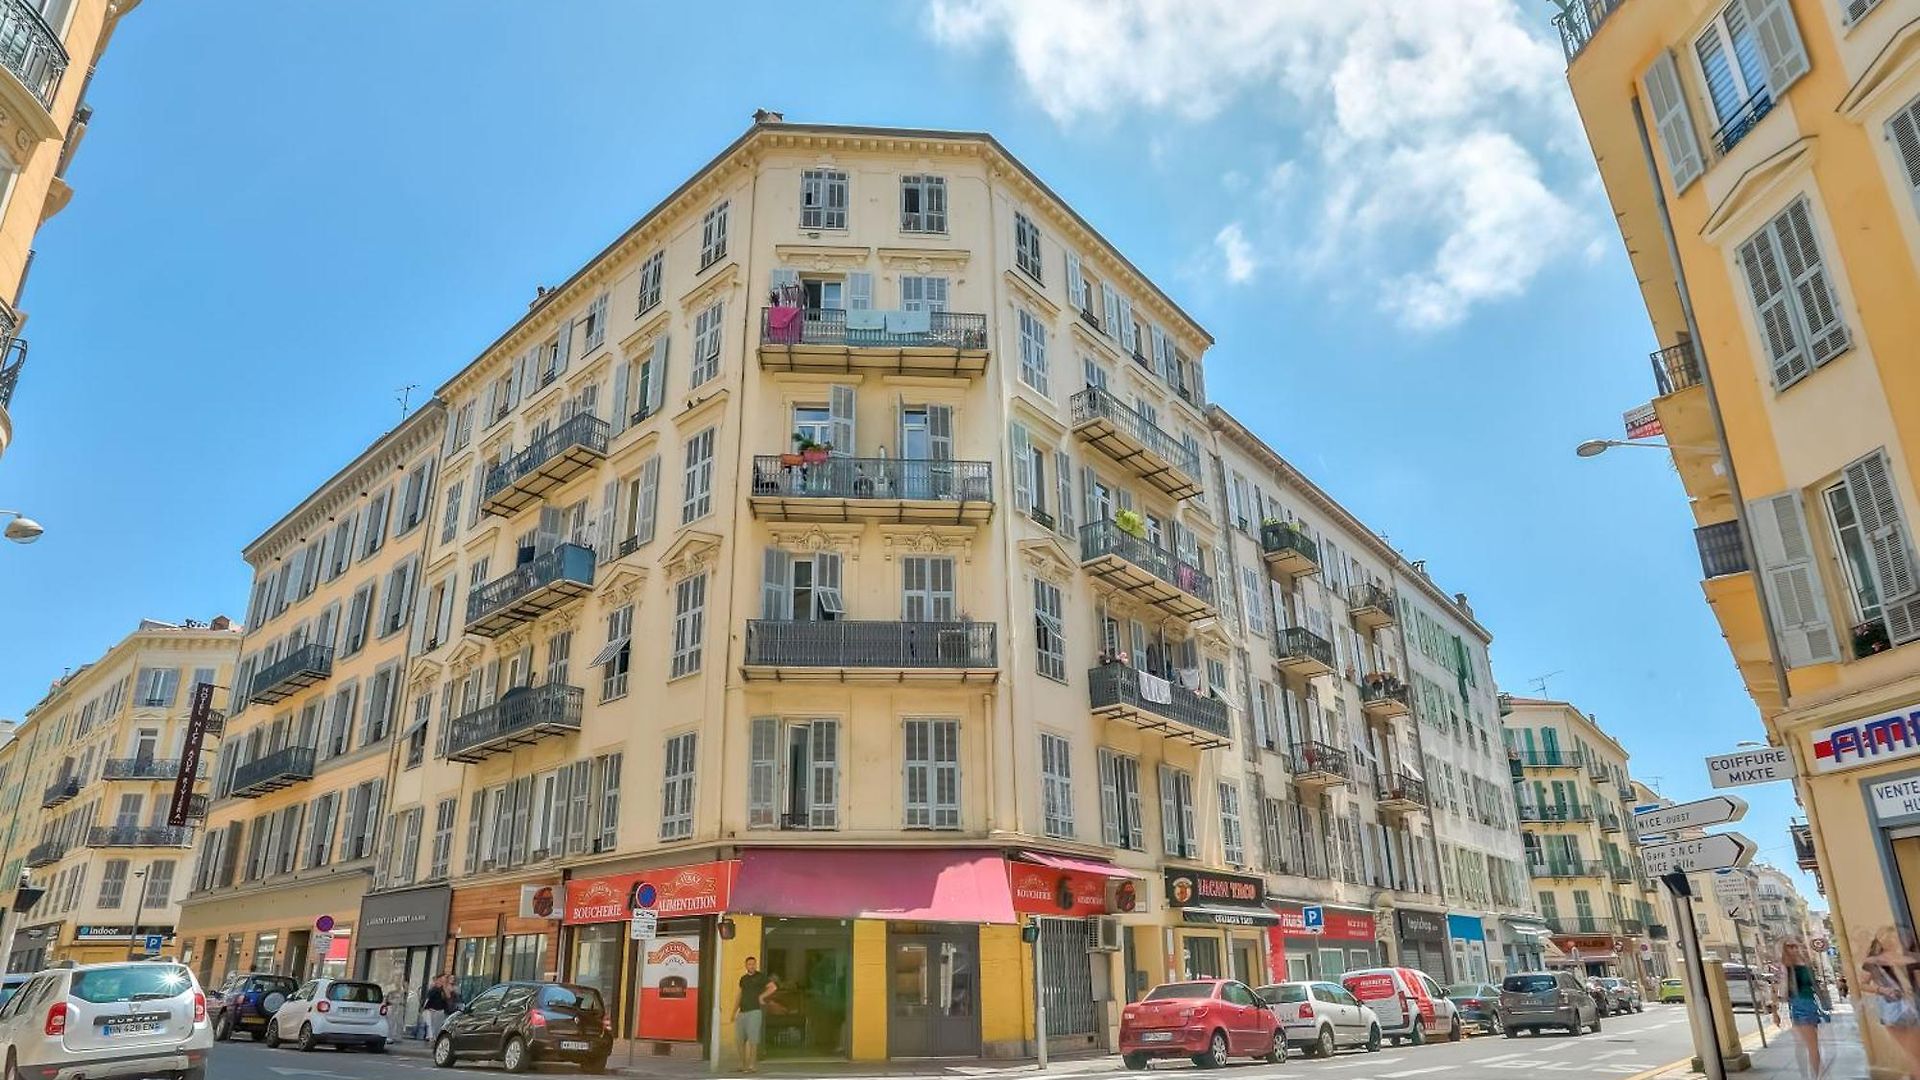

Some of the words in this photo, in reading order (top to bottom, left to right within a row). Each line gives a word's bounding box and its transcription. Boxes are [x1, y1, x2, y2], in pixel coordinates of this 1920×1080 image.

[199, 686, 209, 716] HOTEL
[191, 721, 202, 745] NICE
[185, 749, 194, 773] AZUR
[1711, 750, 1786, 771] COIFFURE
[1729, 767, 1776, 783] MIXTE
[174, 777, 189, 820] RIVIERA
[1876, 780, 1920, 799] VENTE
[1639, 817, 1661, 829] NICE
[1649, 861, 1668, 873] NICE
[573, 905, 622, 919] BOUCHERIE
[658, 895, 716, 911] ALIMENTATION
[1308, 910, 1317, 923] P
[89, 927, 118, 935] indoor
[149, 938, 158, 947] P
